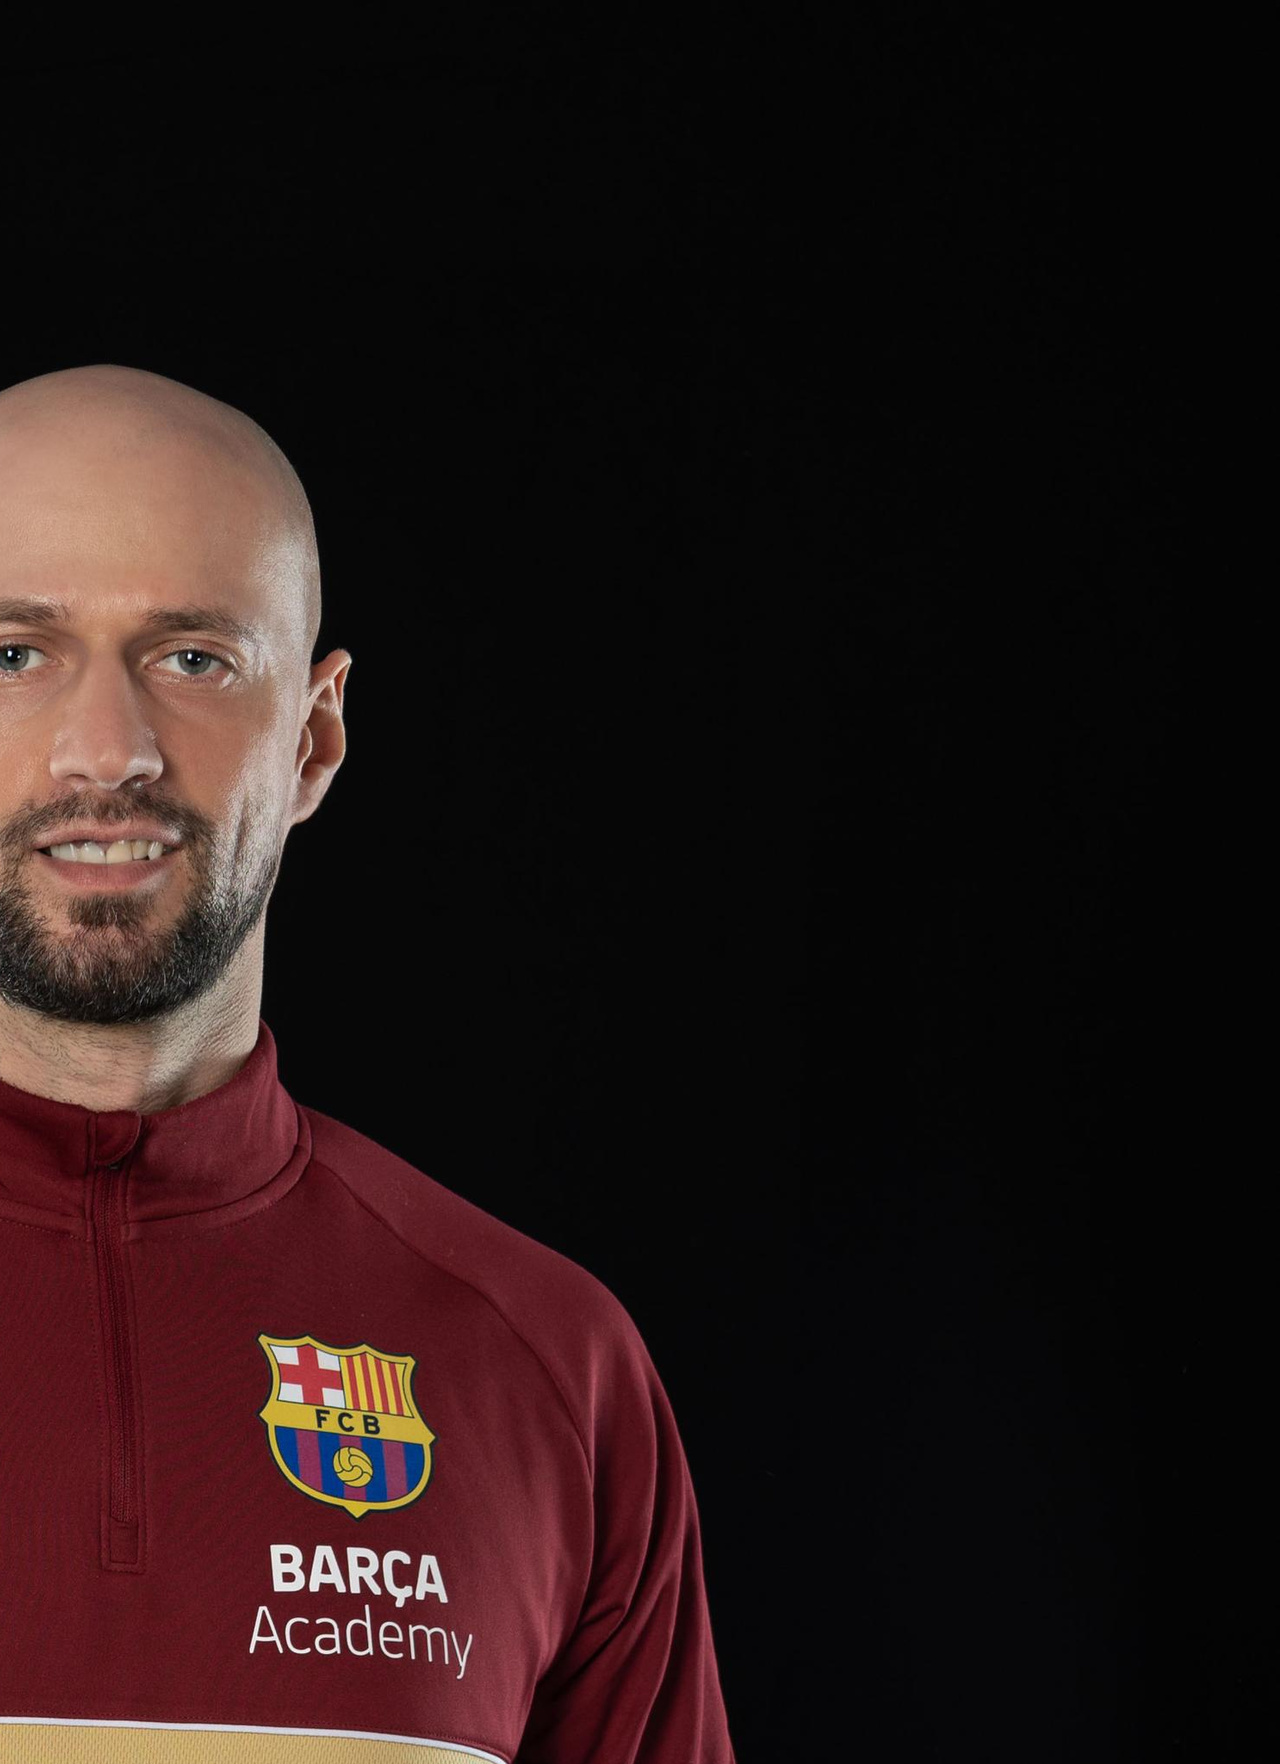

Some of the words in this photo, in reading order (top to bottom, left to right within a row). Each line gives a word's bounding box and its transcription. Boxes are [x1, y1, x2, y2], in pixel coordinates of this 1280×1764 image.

[314, 1408, 381, 1435] FCB
[270, 1544, 449, 1608] BARÇA
[249, 1604, 473, 1680] Academy
